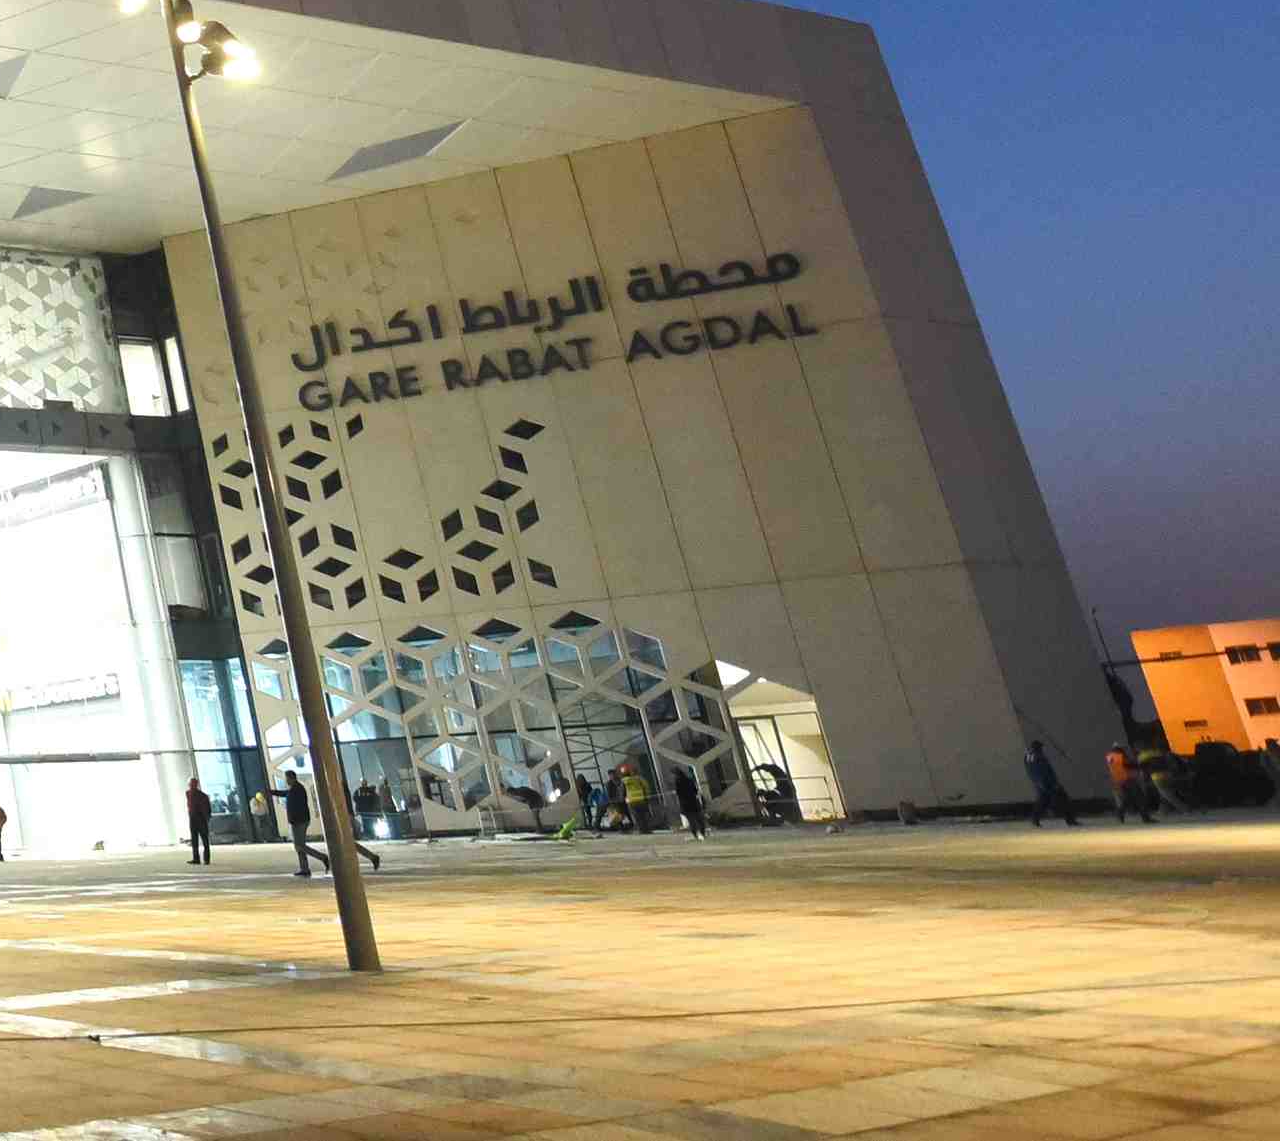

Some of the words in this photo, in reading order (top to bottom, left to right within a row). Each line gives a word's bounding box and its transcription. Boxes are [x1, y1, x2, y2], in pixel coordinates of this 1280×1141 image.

[459, 276, 603, 334] الرباط
[627, 253, 800, 302] محطة
[298, 366, 422, 411] GARE
[440, 337, 593, 391] RABAT
[625, 304, 819, 364] AGDAL
